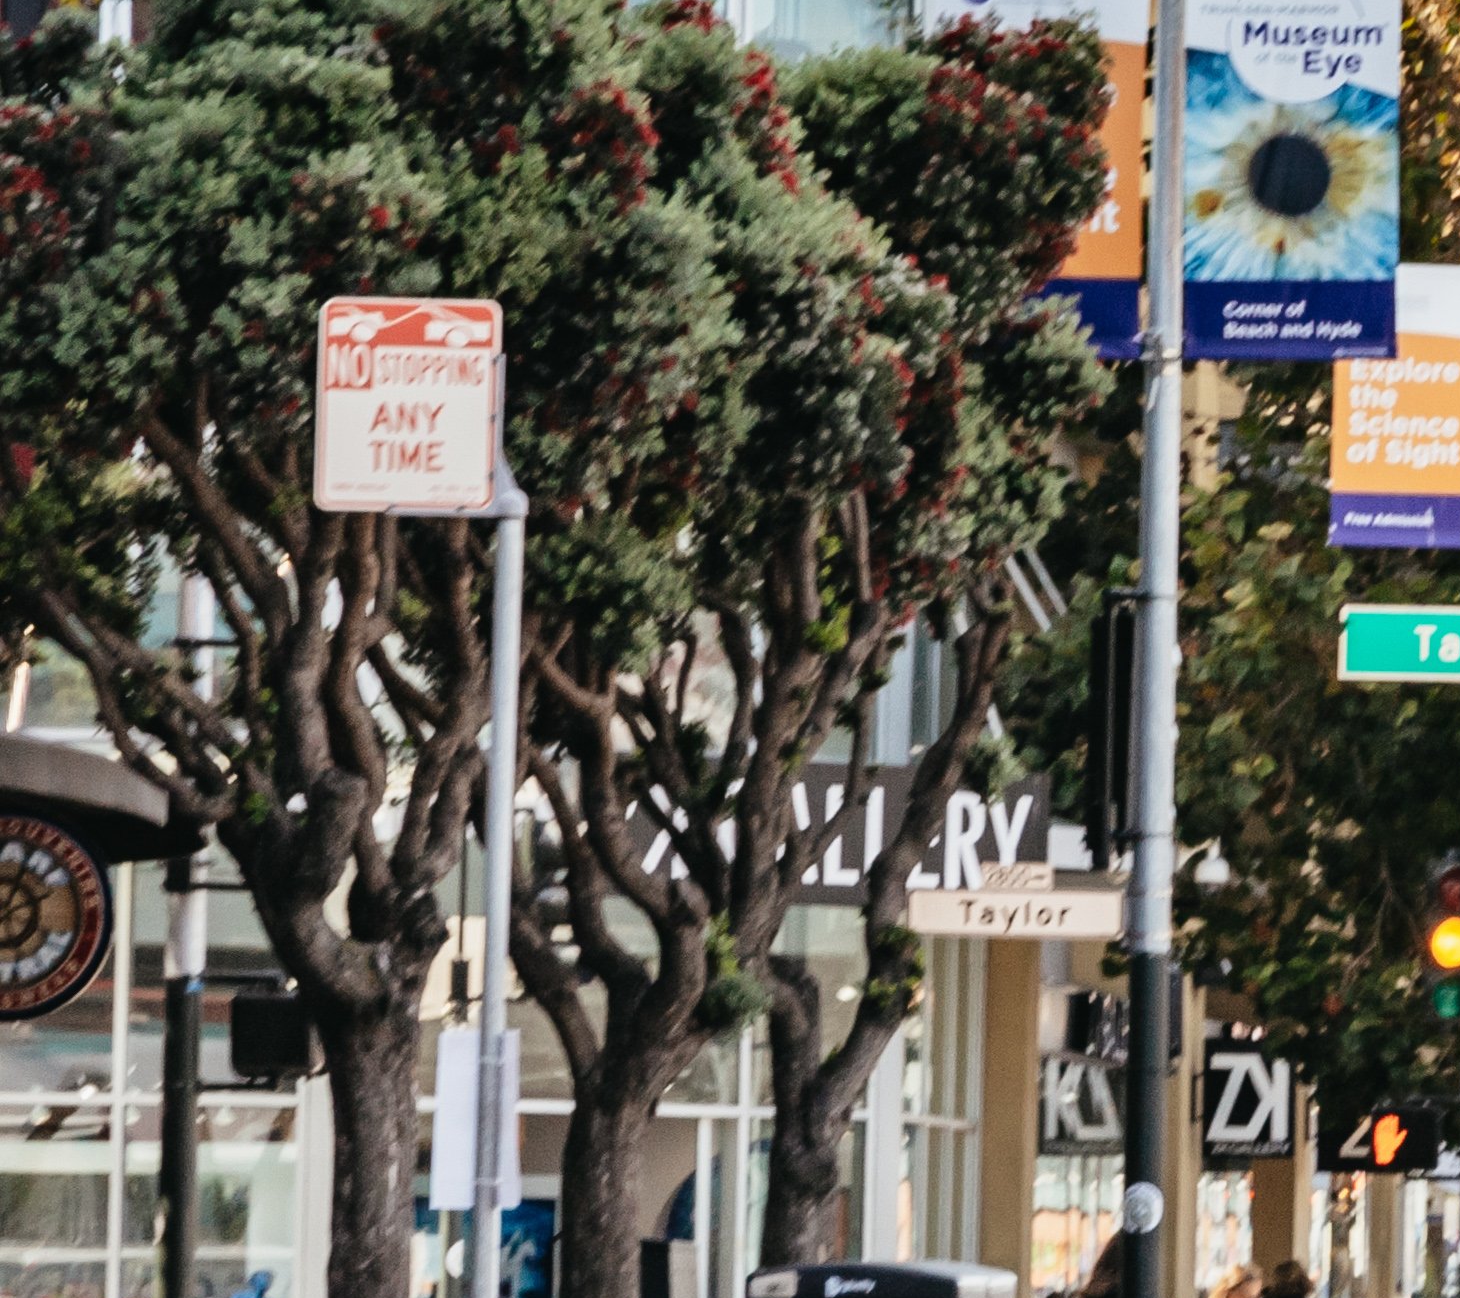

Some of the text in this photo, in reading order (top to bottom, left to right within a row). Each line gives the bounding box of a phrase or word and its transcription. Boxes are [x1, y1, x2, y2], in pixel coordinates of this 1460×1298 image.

[1242, 20, 1382, 47] Museum
[1302, 48, 1362, 80] Eye
[1222, 299, 1307, 319] Corner of
[1279, 322, 1313, 340] and
[1315, 321, 1363, 342] Hyde
[327, 344, 487, 388] NO STOPPING
[1349, 384, 1398, 411] the
[369, 402, 445, 434] ANY
[1349, 412, 1460, 438] Science
[368, 440, 445, 473] TIME
[1346, 440, 1378, 464] of
[959, 899, 1073, 933] Taylor
